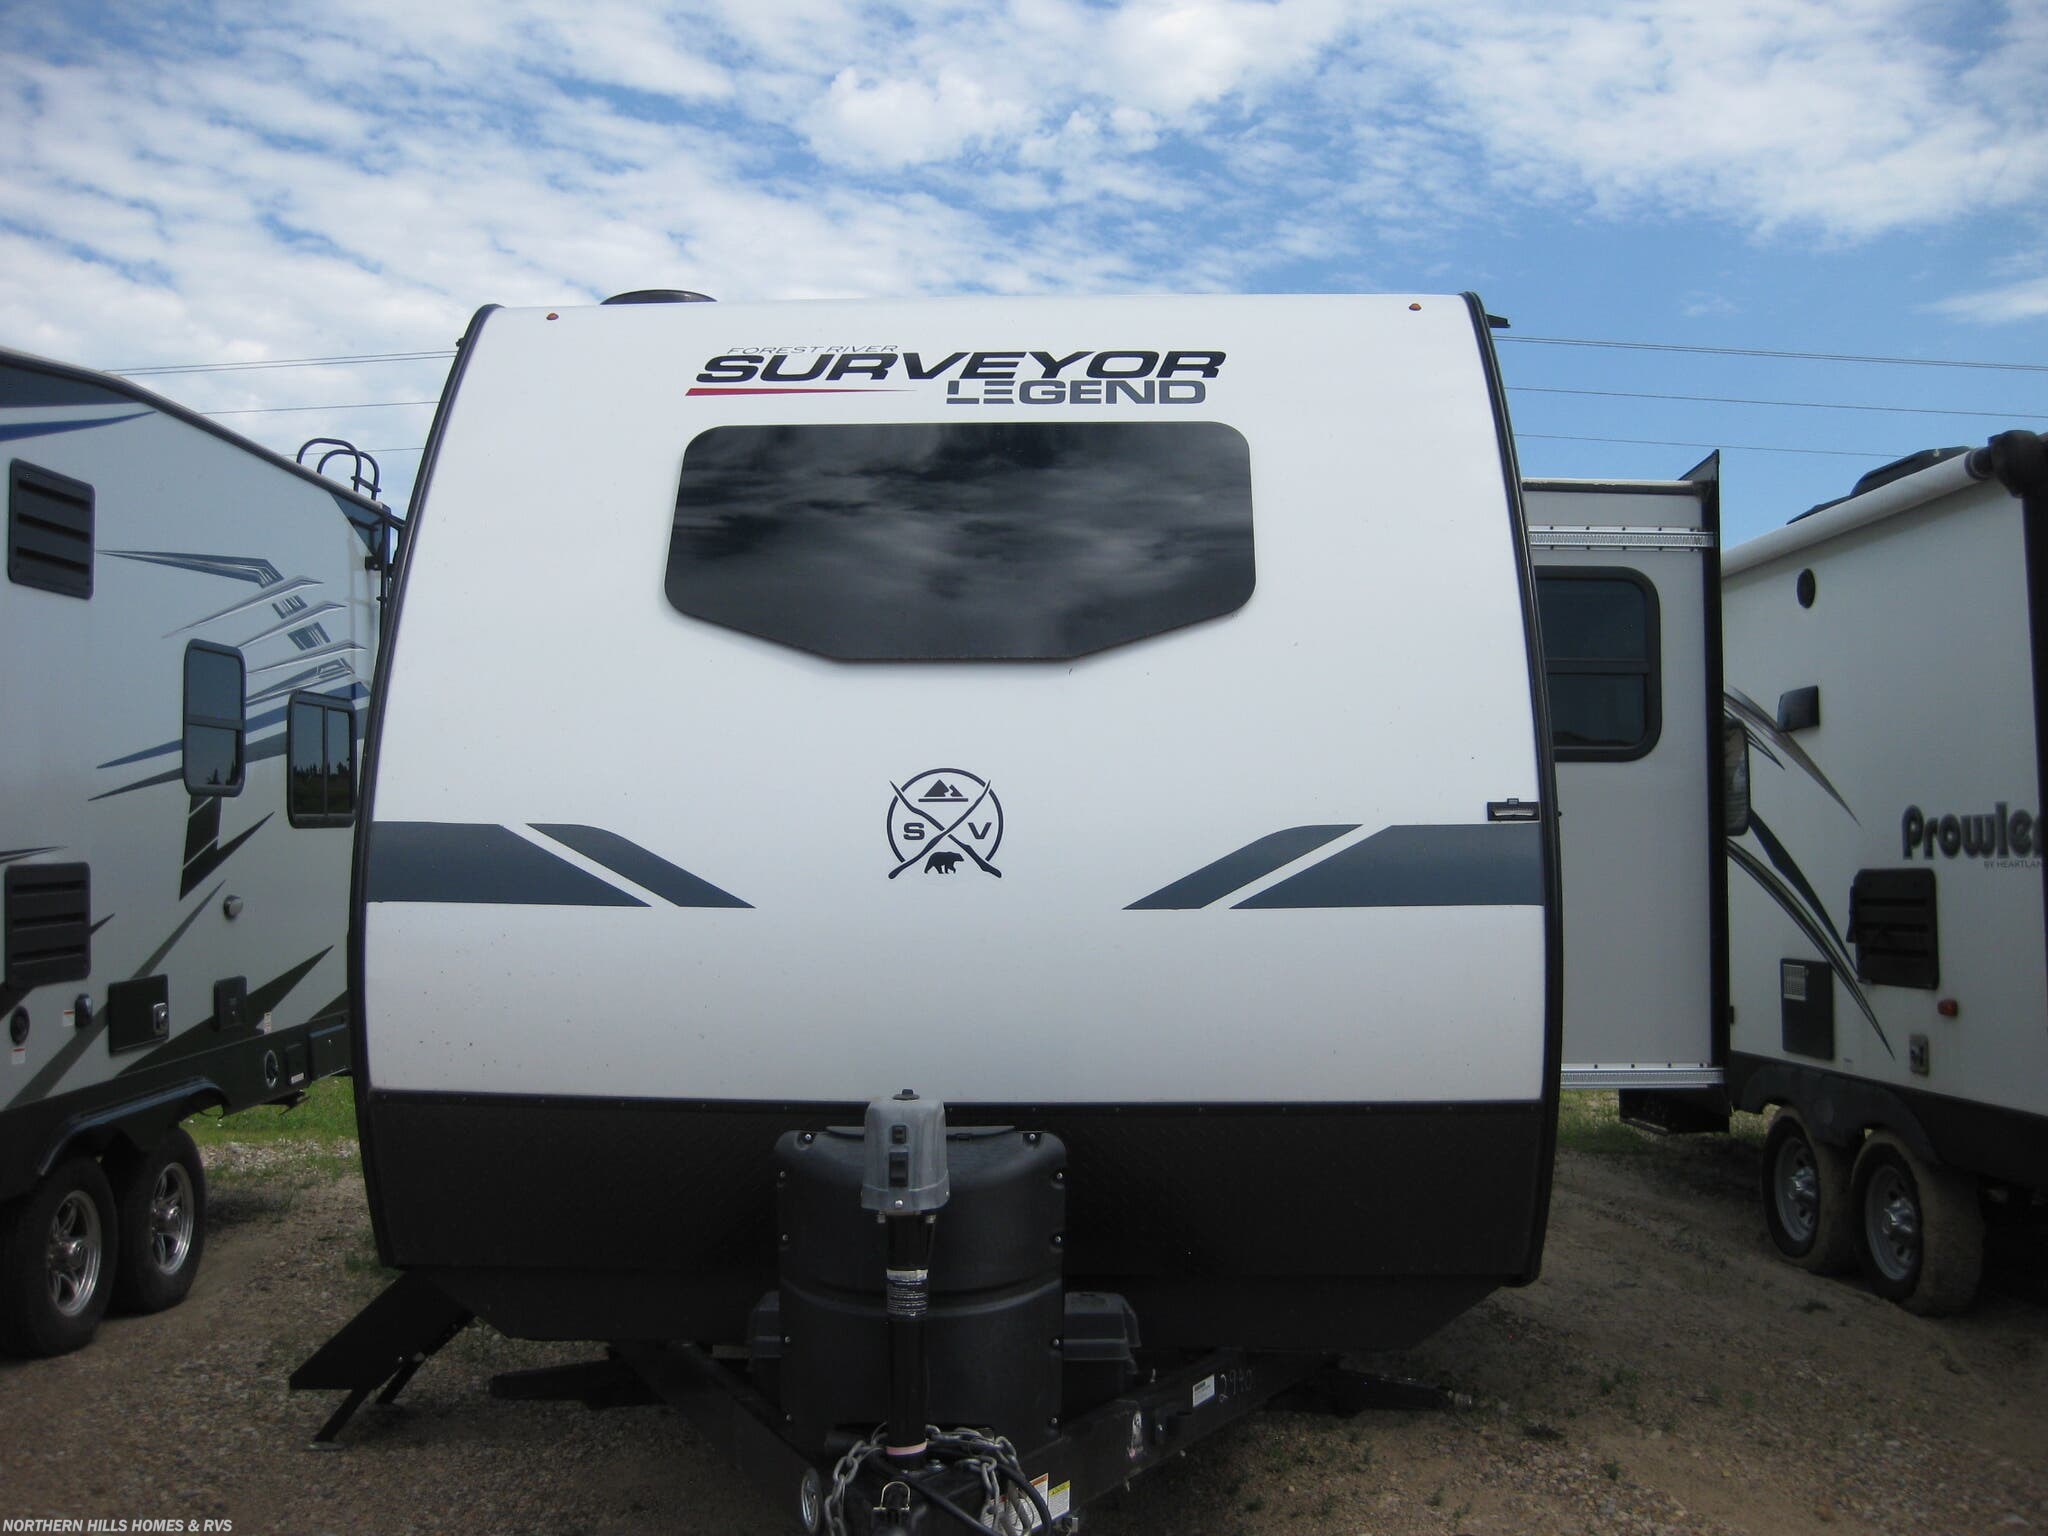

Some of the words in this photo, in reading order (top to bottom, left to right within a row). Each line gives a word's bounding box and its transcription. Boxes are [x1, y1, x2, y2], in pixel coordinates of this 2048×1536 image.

[727, 345, 826, 356] FOREST
[827, 344, 899, 354] RIVER
[695, 350, 1227, 383] SURVEYOR
[945, 379, 1207, 405] LEGEND
[903, 822, 925, 841] S
[967, 821, 992, 840] V
